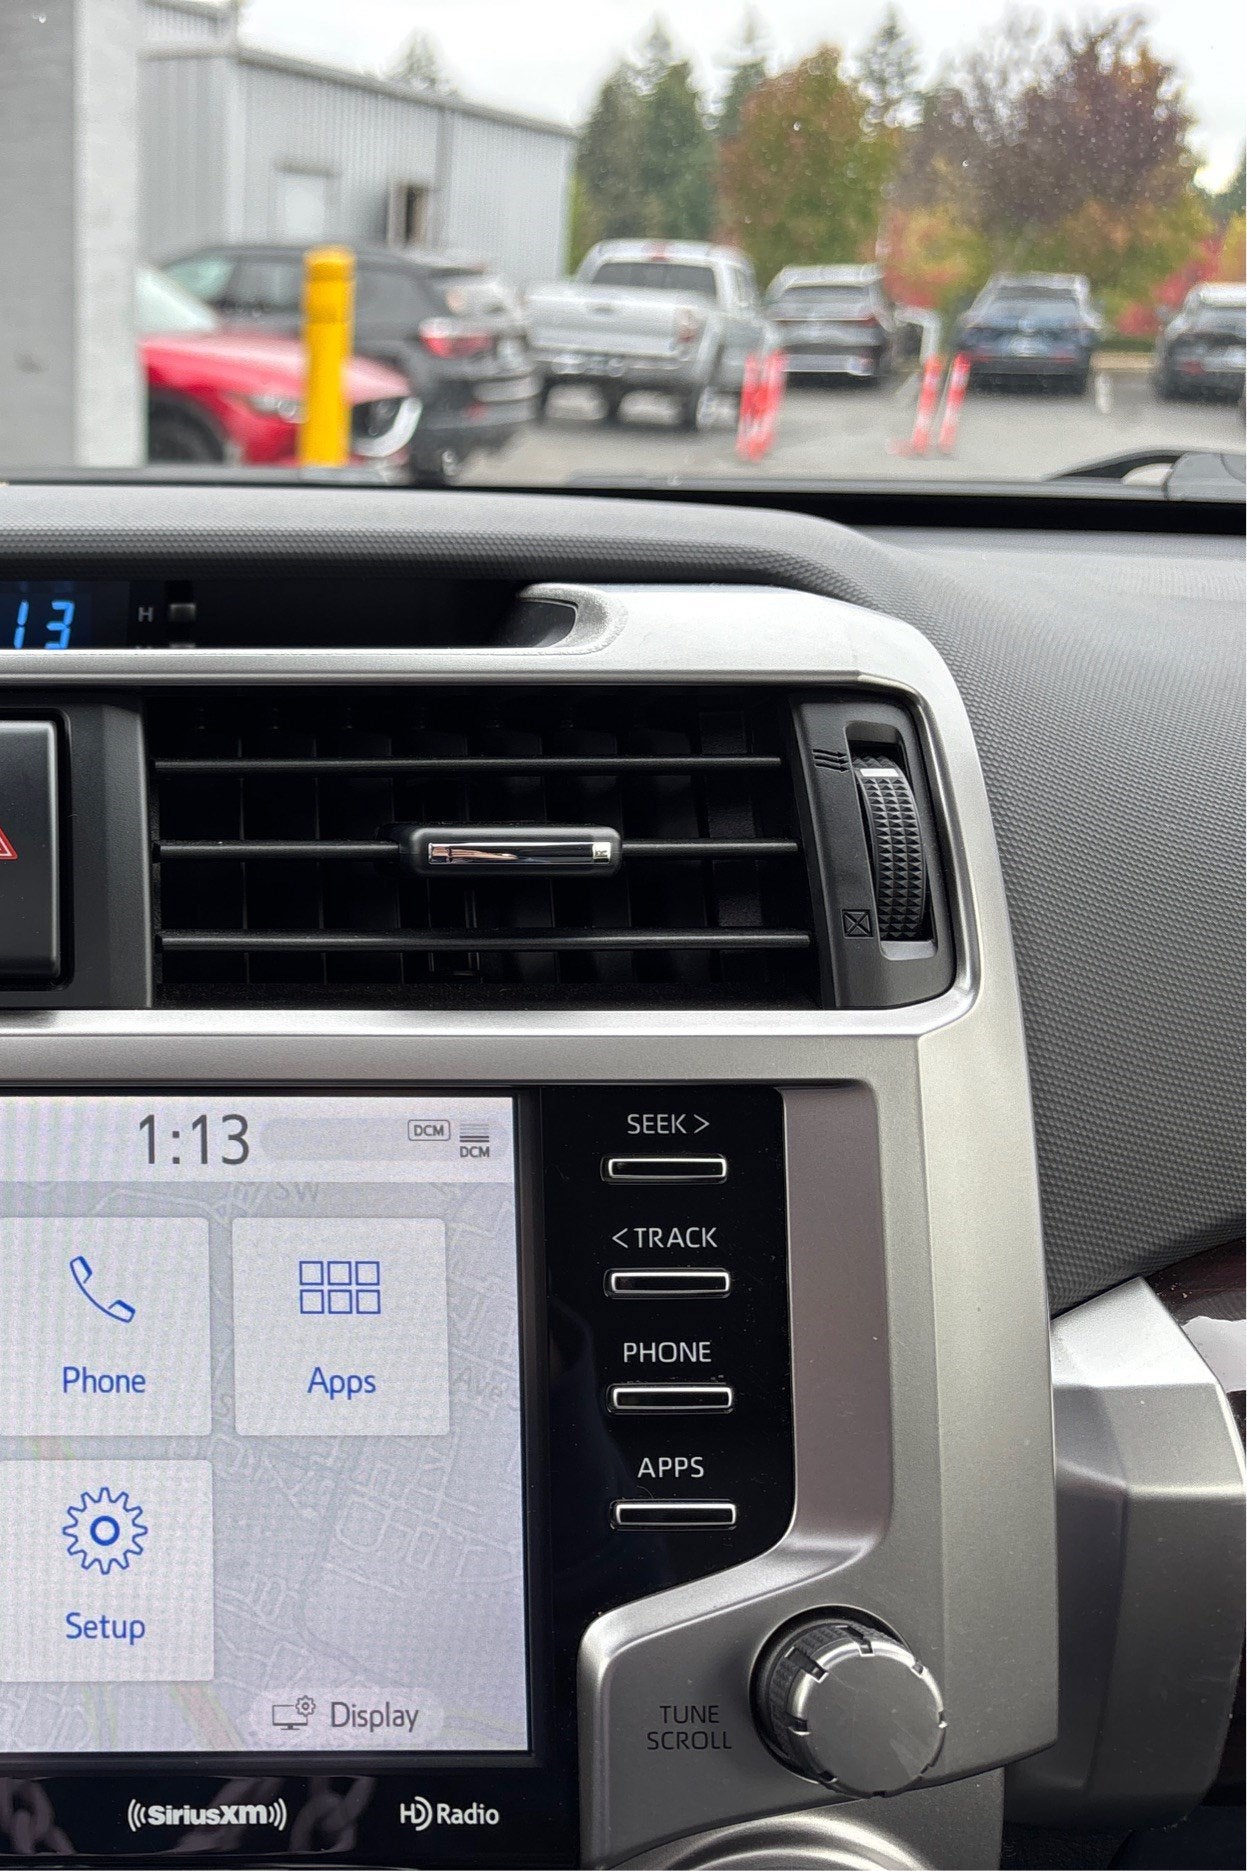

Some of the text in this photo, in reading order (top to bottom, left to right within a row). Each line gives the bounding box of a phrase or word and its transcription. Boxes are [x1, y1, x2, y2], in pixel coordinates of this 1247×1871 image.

[138, 607, 153, 621] H
[140, 1114, 249, 1165] 1:13
[414, 1125, 444, 1136] DCM
[460, 1146, 490, 1158] DCM
[624, 1342, 711, 1362] PHONE
[63, 1366, 146, 1393] Phone
[307, 1367, 376, 1400] Apps
[638, 1457, 704, 1478] APPS
[66, 1612, 145, 1645] Setup
[331, 1701, 419, 1733] Display
[659, 1705, 720, 1724] TUNE
[647, 1731, 732, 1750] SCROLL
[400, 1799, 499, 1828] HD Radio
